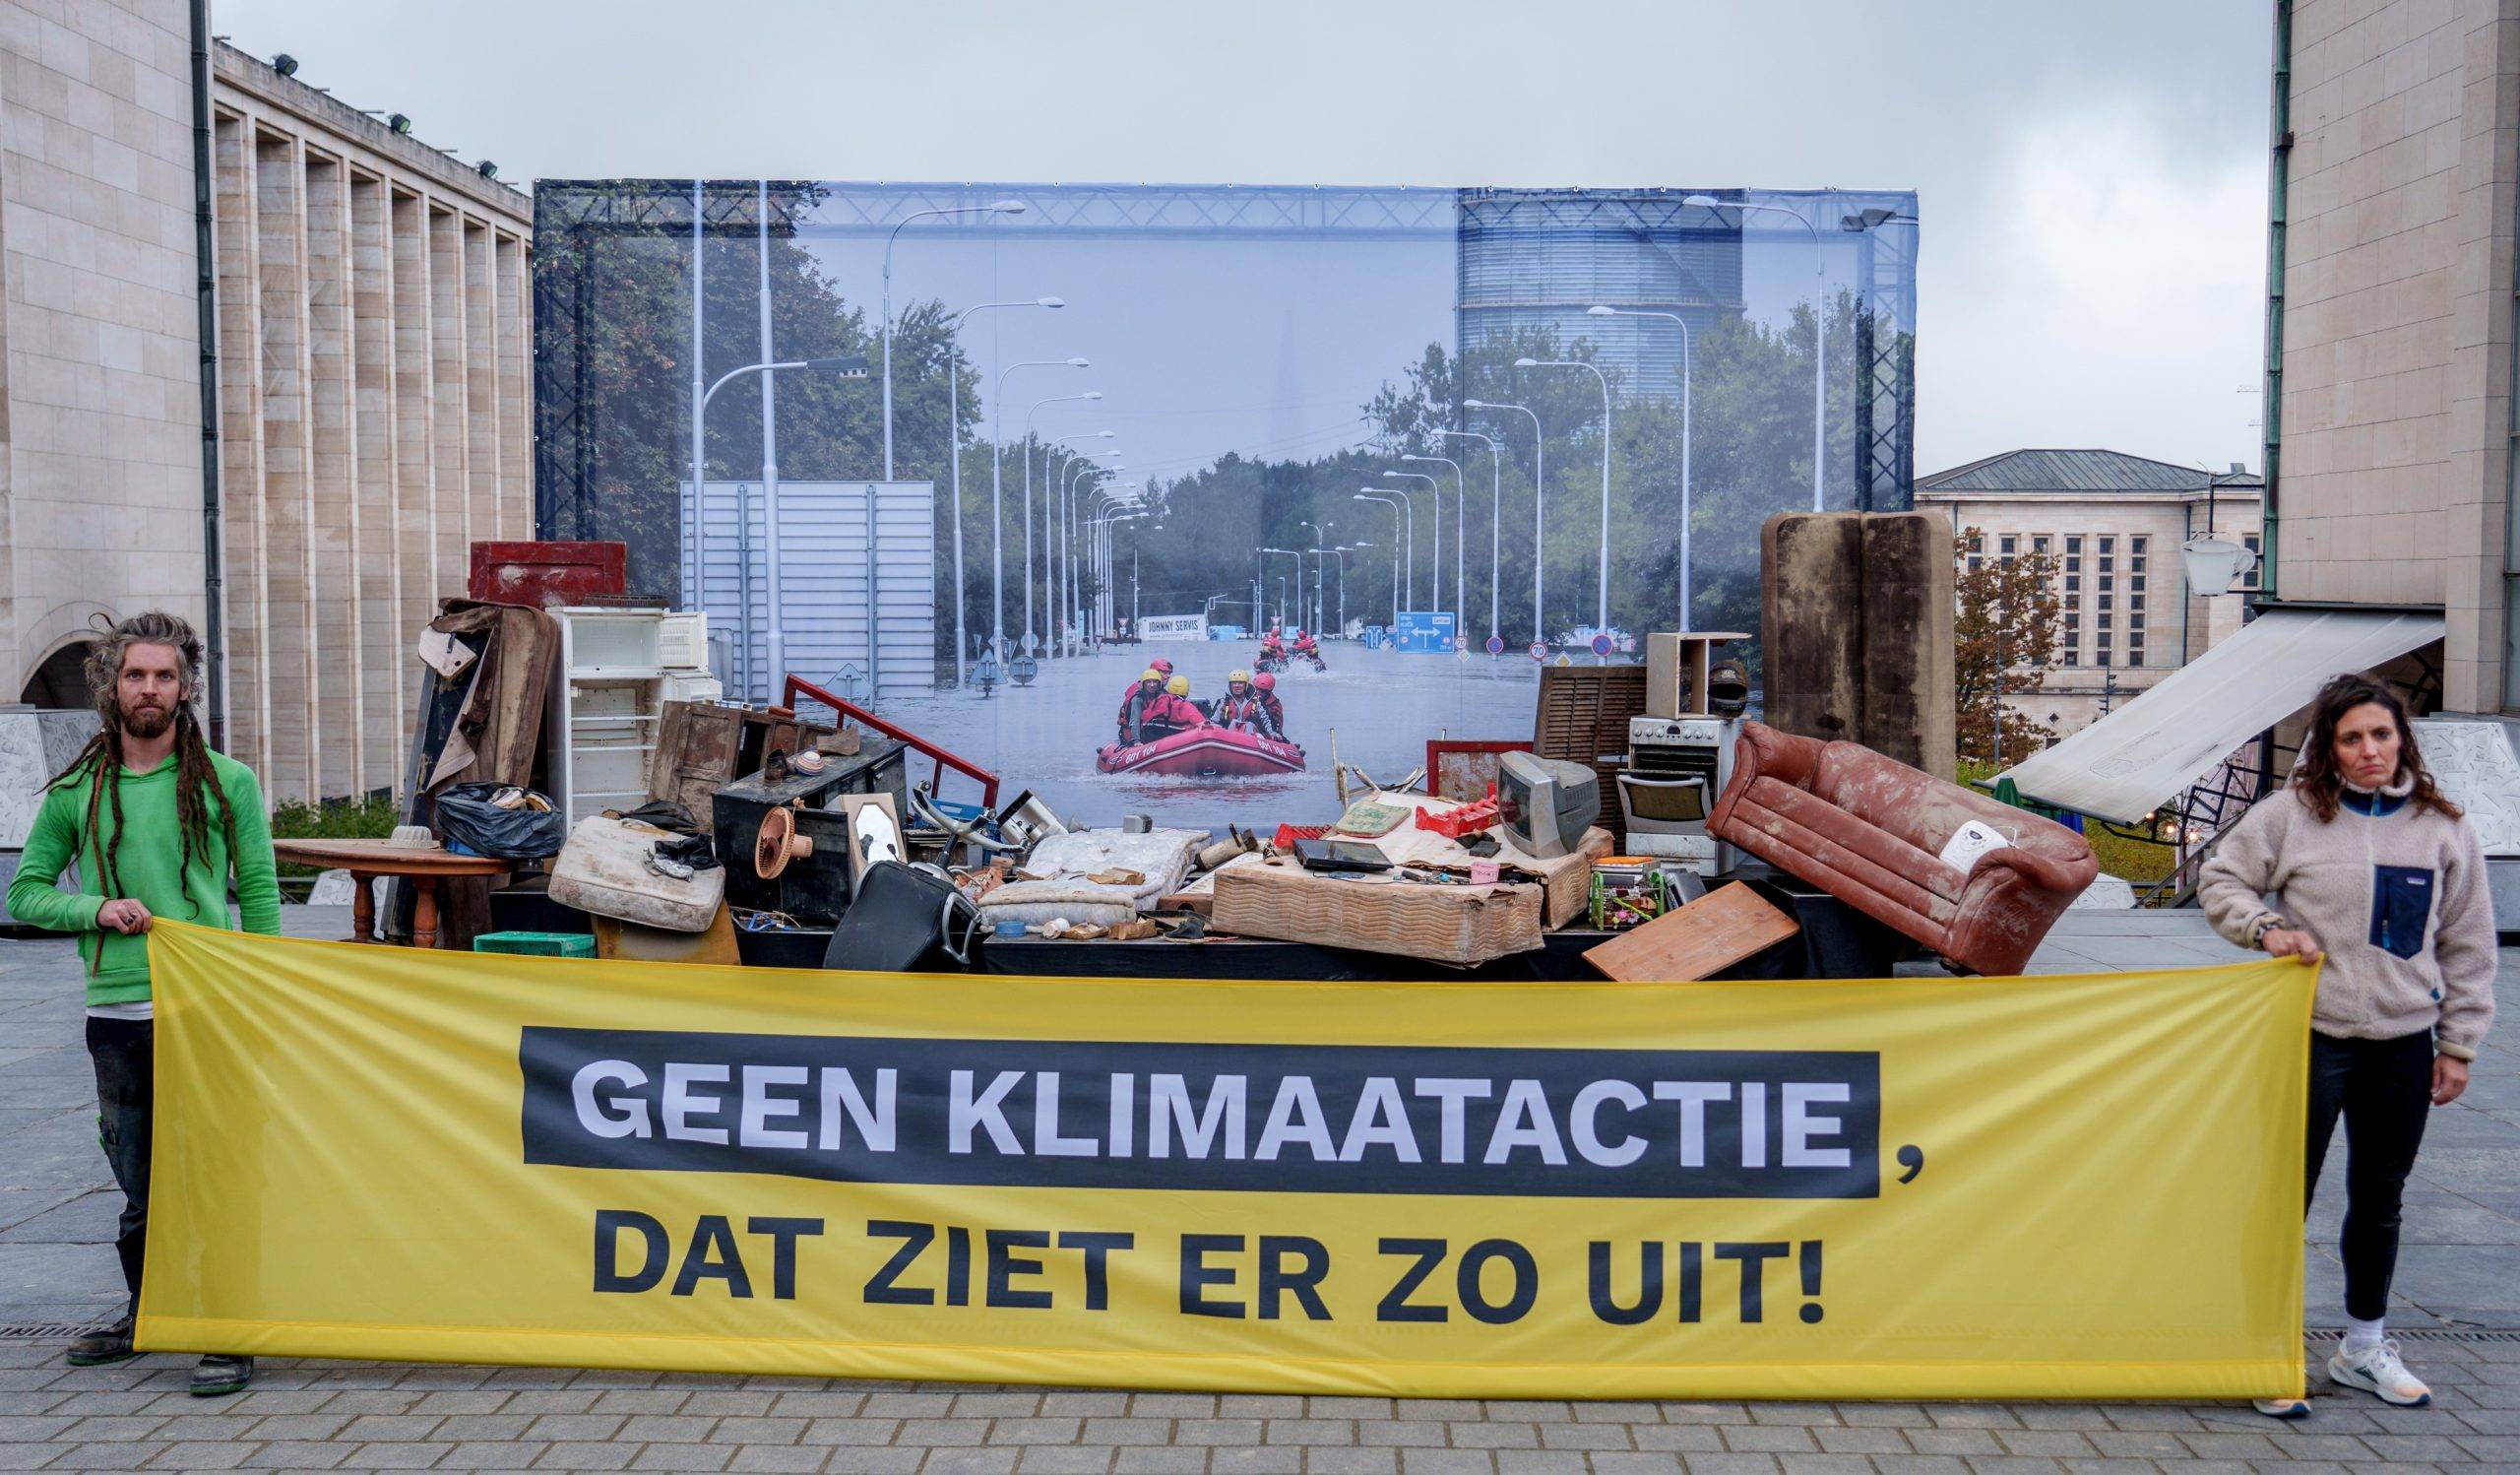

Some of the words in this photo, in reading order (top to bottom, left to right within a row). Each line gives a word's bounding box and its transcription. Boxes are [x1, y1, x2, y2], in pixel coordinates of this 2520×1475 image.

[1149, 621, 1173, 633] JOHNNY
[1175, 619, 1199, 631] SERVIS
[1533, 646, 1544, 655] 70
[571, 1059, 898, 1152] GEEN
[949, 1069, 1923, 1185] KLIMAATACTIE,
[594, 1208, 824, 1300] DAT
[863, 1219, 1134, 1311] ZIET
[1180, 1233, 1334, 1321] ER
[1377, 1238, 1539, 1324] ZO
[1588, 1239, 1824, 1324] UIT!
